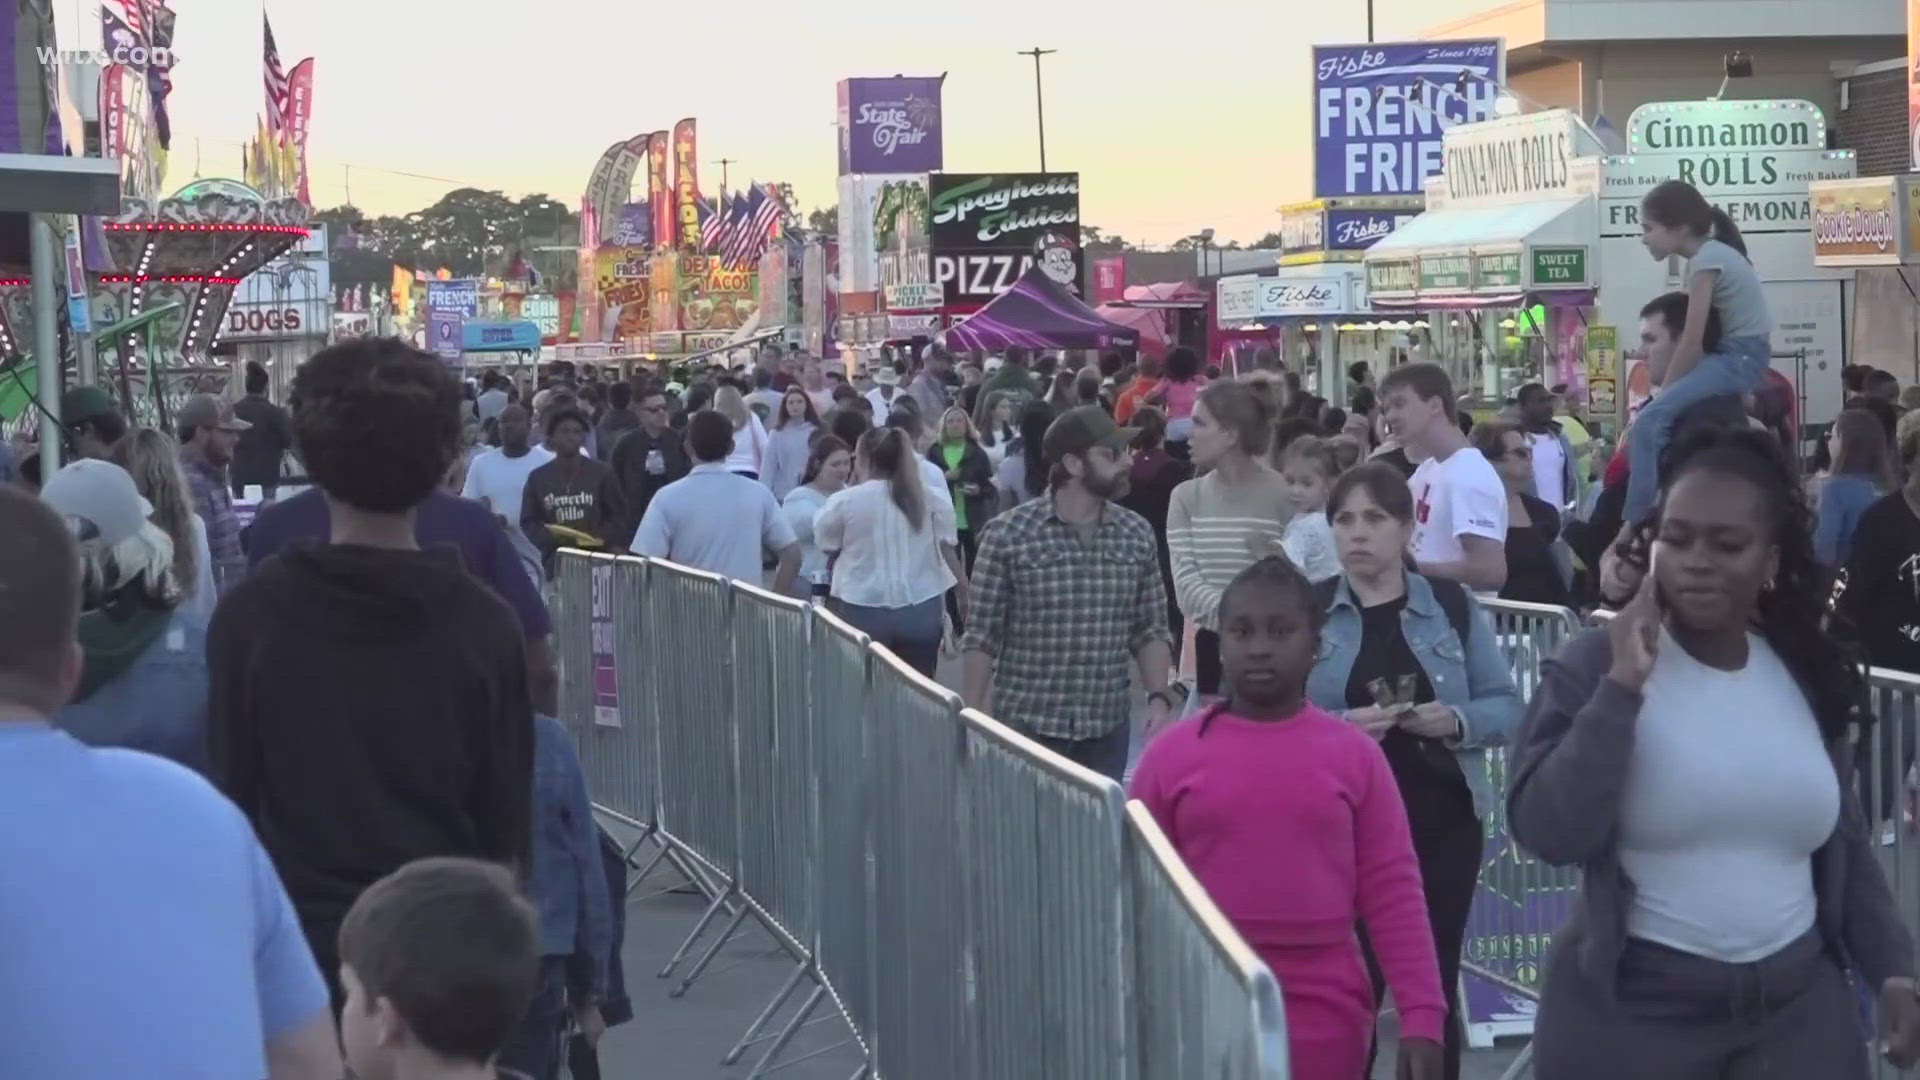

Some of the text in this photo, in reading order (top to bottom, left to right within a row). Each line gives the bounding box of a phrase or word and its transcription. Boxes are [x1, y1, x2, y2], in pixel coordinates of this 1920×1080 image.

[1426, 47, 1496, 61] Since 1958
[1318, 50, 1386, 81] Fiske
[856, 103, 906, 125] State
[1320, 82, 1496, 138] FRENCH
[873, 121, 928, 156] Fair
[1645, 117, 1808, 149] Cinnamon
[1345, 141, 1443, 193] FRIE
[1448, 132, 1568, 200] CINNAMON ROLLS
[1678, 156, 1778, 187] ROLLS
[1786, 170, 1850, 183] Fresh Baked
[1606, 177, 1634, 187] Fresh
[932, 177, 1079, 223] Spaghetti
[1713, 201, 1811, 223] EMONA
[977, 206, 1078, 242] Eddies
[1336, 217, 1390, 243] Fiske
[1815, 209, 1852, 245] Cookie
[1538, 254, 1579, 268] SWEET
[706, 274, 750, 291] TACOS
[1547, 267, 1571, 279] TEA
[428, 290, 475, 307] FRENCH
[893, 285, 927, 296] PICKLE
[895, 296, 925, 307] PIZZA
[1267, 285, 1331, 303] Fiske
[520, 300, 559, 318] CORN
[228, 309, 300, 333] DOGS
[544, 491, 593, 508] Beverly
[556, 506, 584, 524] Hills
[592, 565, 612, 618] EXIT
